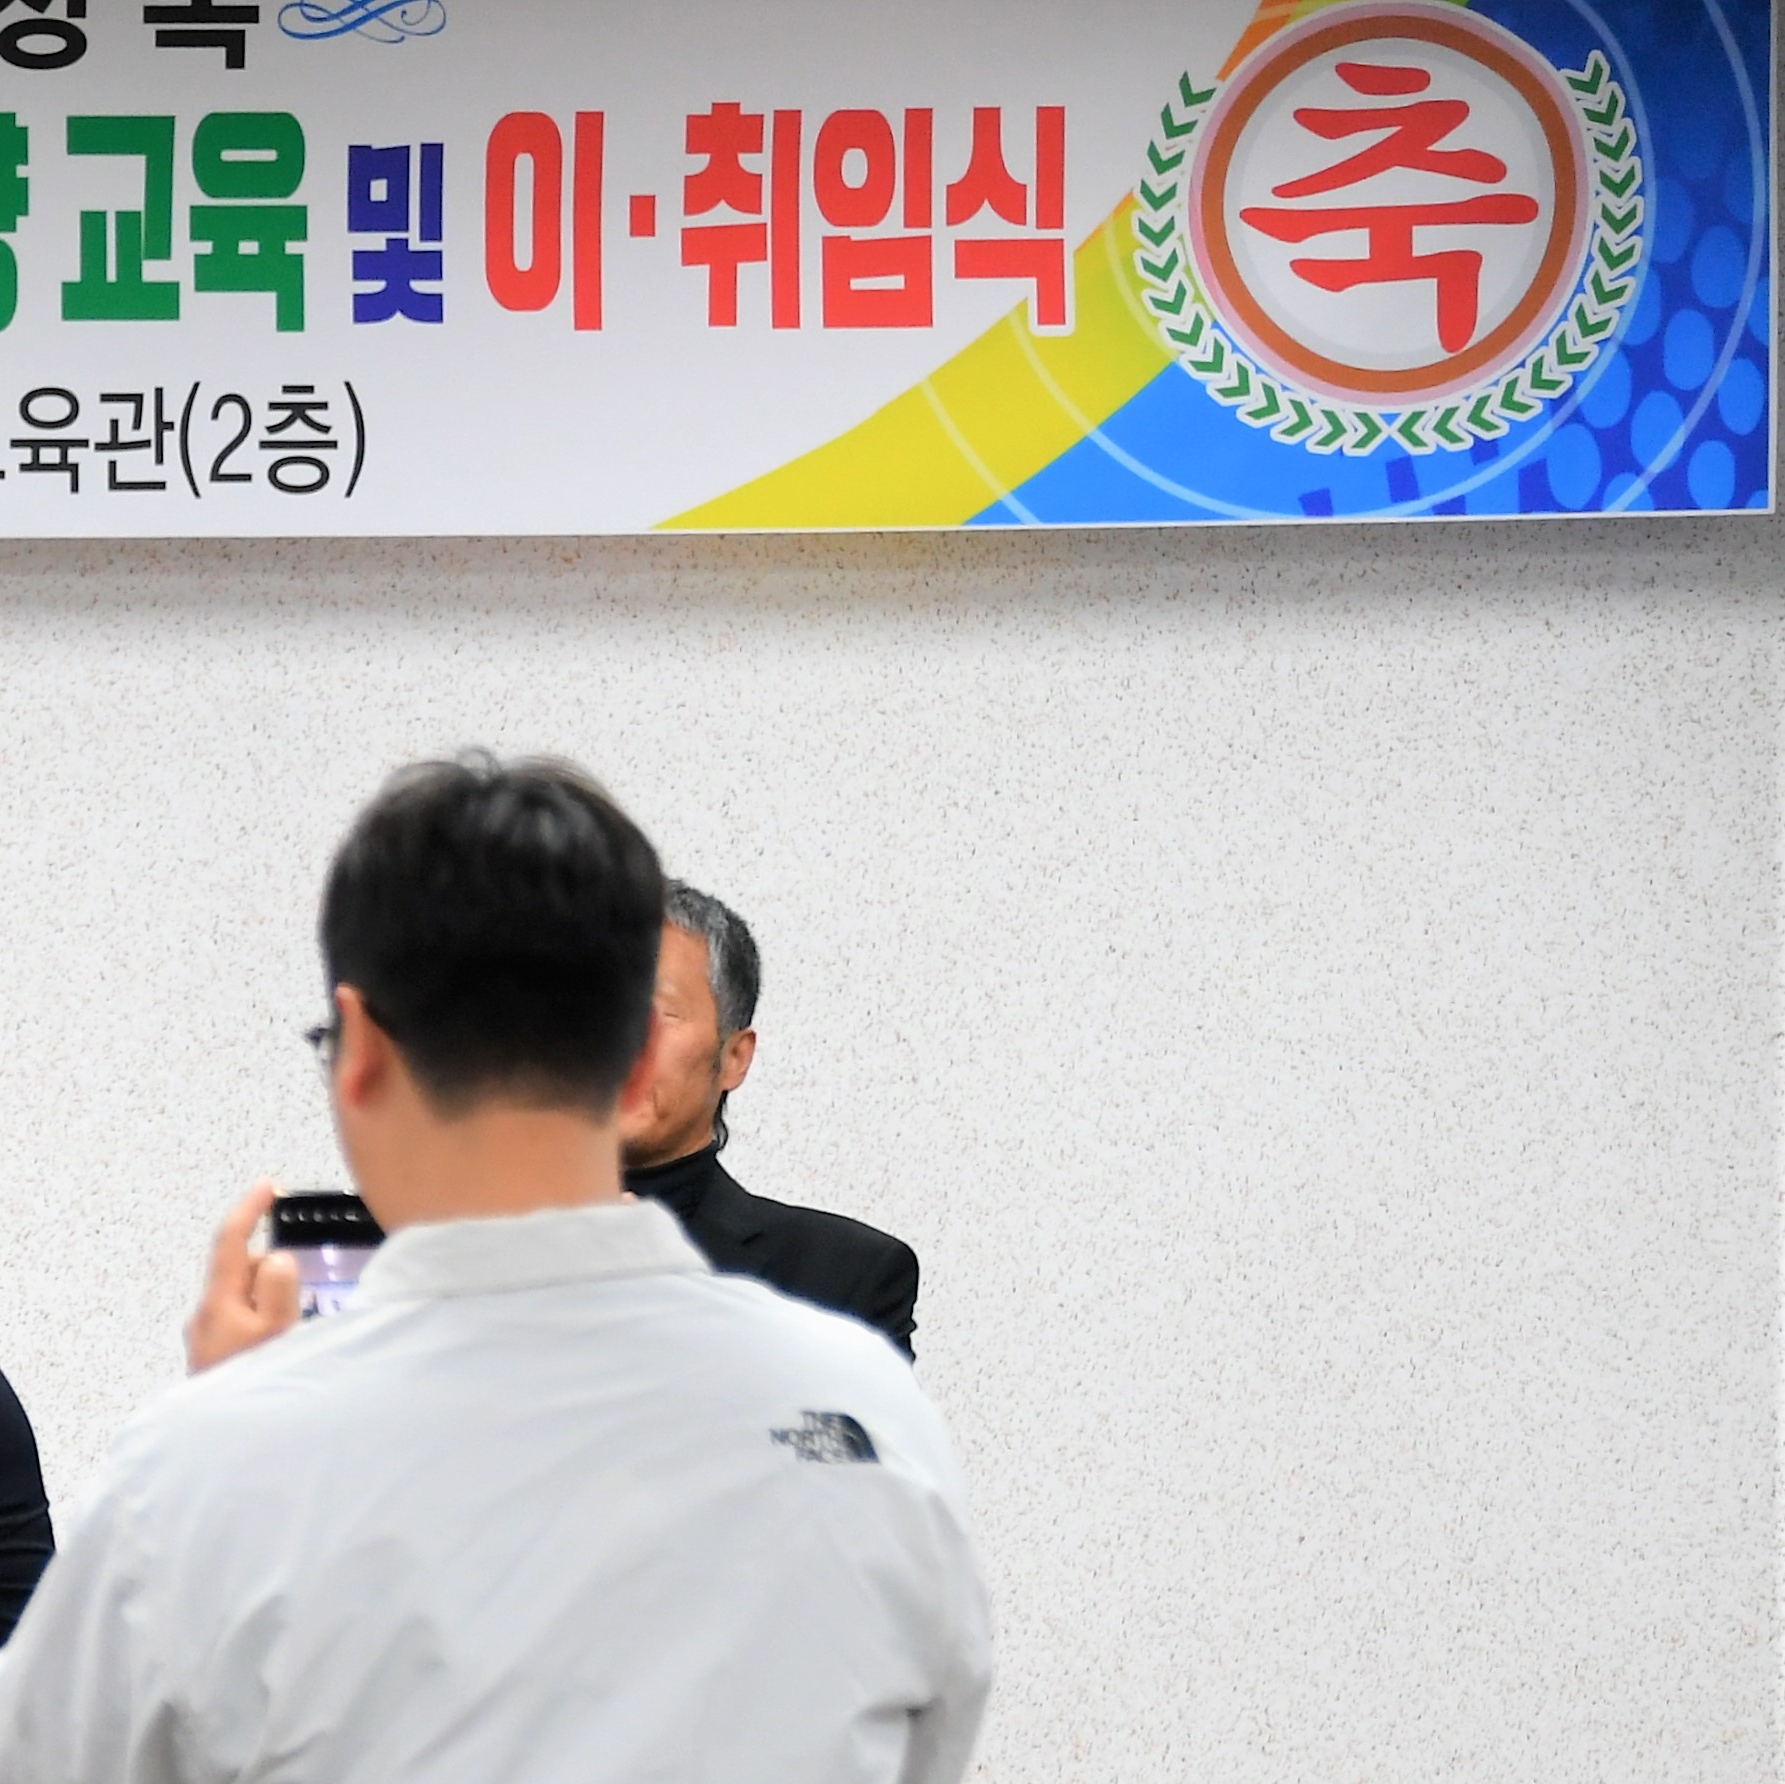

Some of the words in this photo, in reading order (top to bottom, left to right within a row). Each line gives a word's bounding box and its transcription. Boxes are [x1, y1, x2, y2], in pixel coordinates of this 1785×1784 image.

[60, 112, 308, 333] 교육
[347, 142, 444, 324] 및
[1240, 62, 1540, 354] 축
